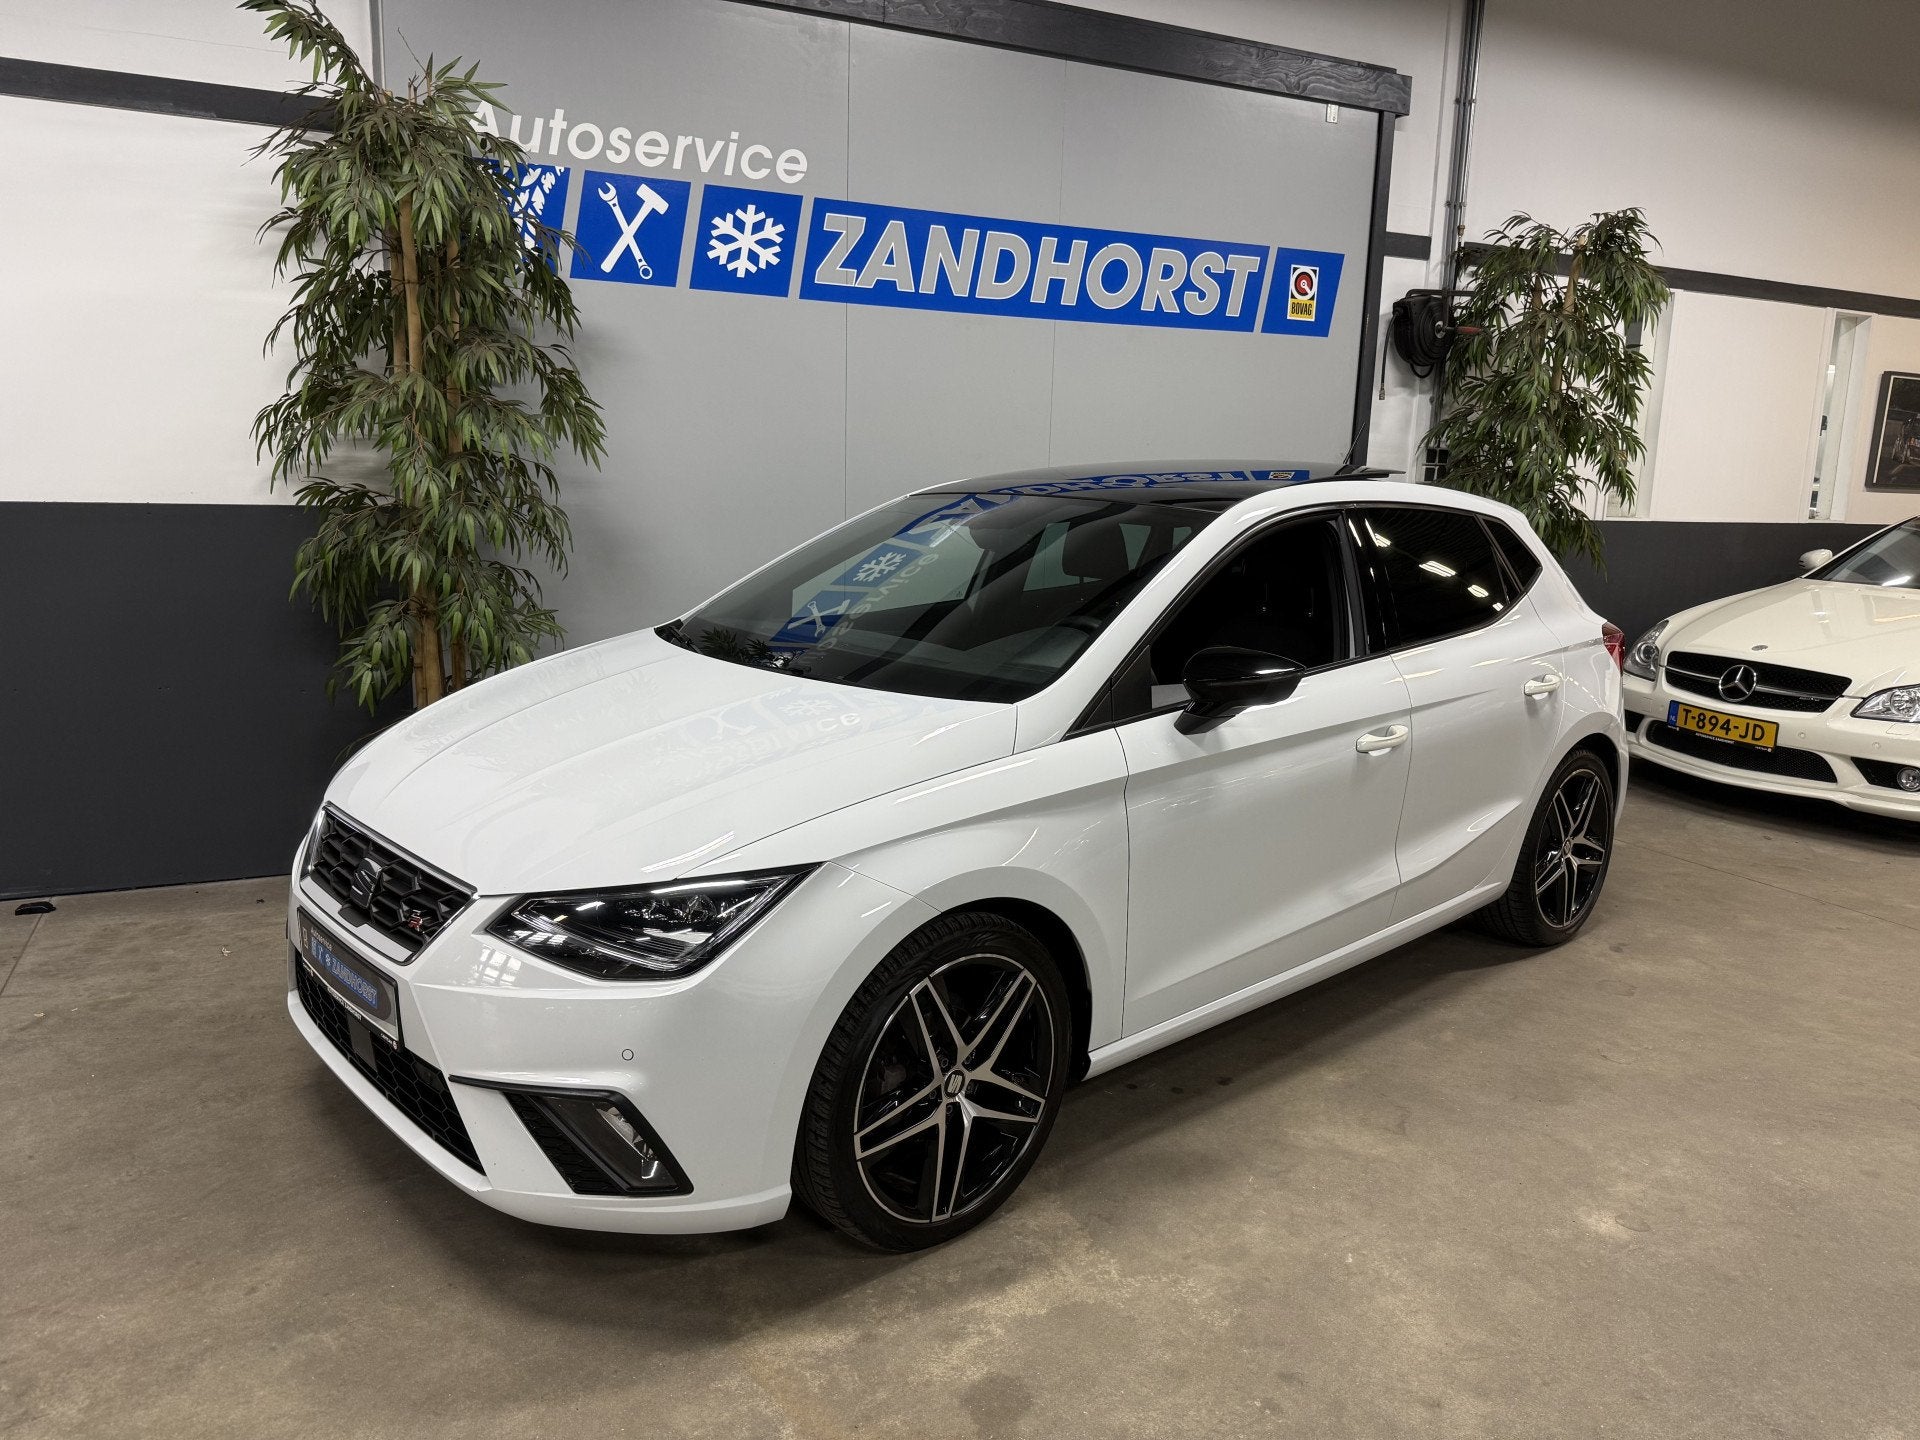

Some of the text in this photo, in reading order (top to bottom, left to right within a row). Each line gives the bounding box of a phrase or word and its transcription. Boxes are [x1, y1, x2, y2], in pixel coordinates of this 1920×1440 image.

[468, 100, 808, 184] Autoservice
[814, 212, 1260, 318] ZANDHORST
[1291, 301, 1313, 316] BOVAG
[1682, 708, 1765, 742] T-894-JD
